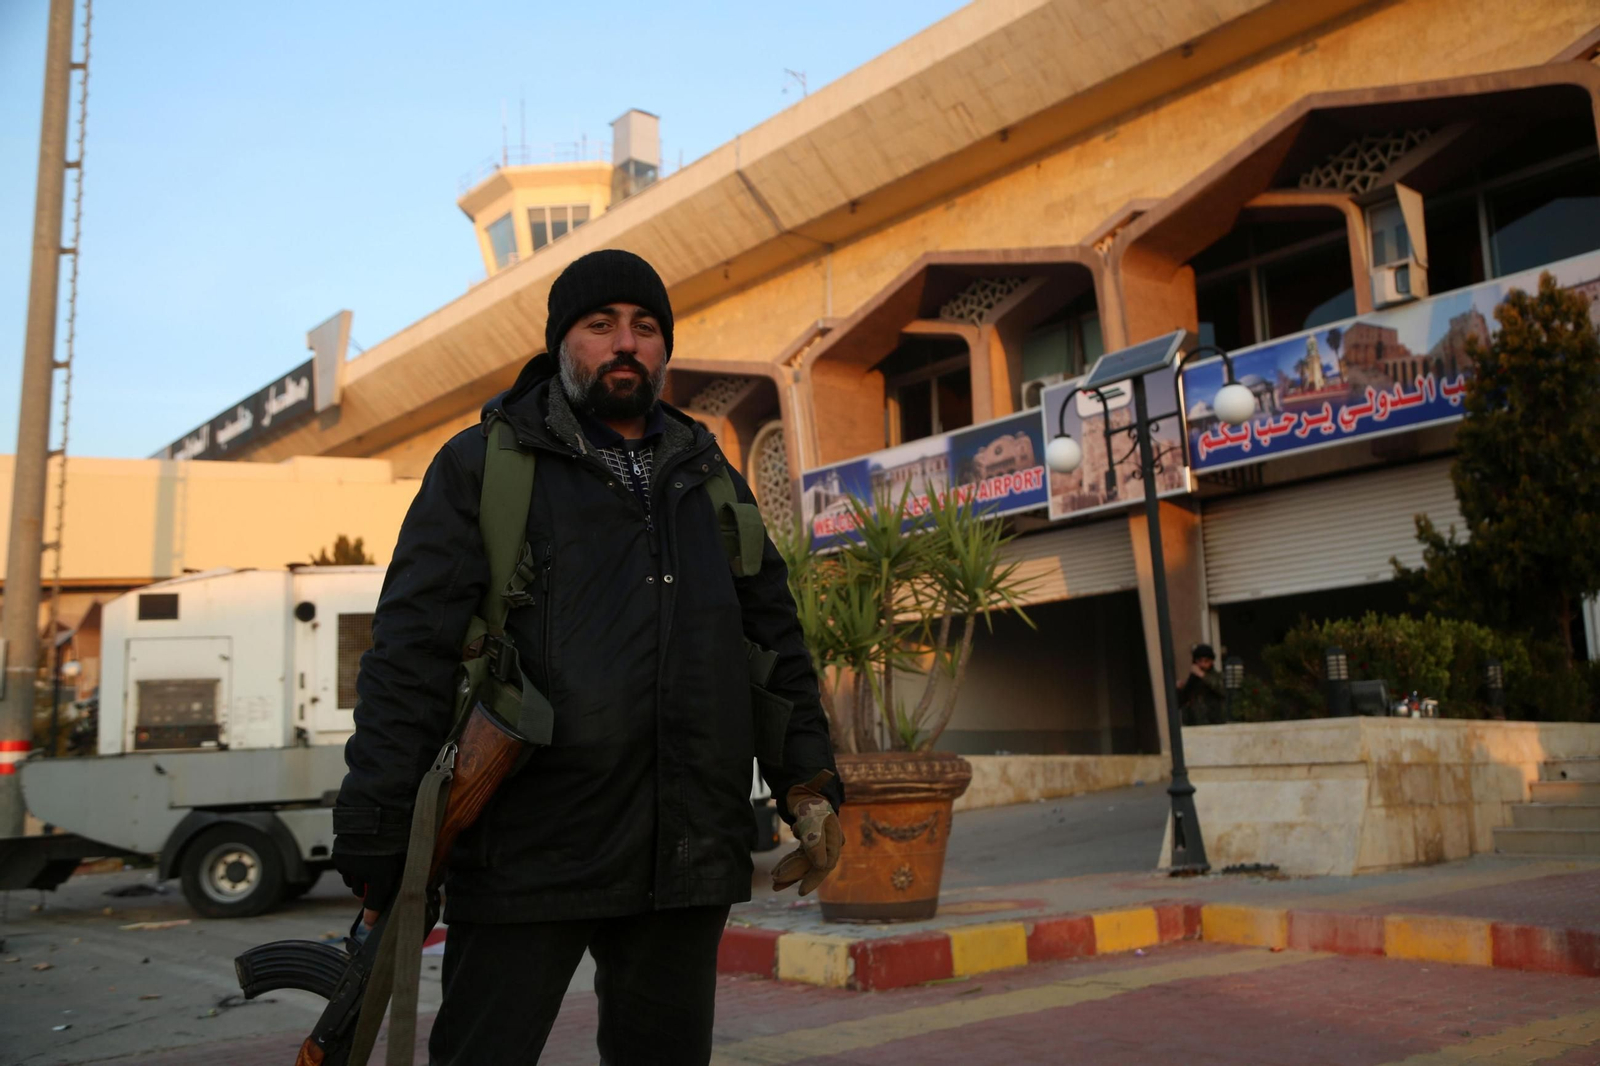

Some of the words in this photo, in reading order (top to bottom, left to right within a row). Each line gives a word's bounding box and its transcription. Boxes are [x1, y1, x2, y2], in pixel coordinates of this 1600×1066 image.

[1254, 401, 1336, 447] يرحب
[1338, 372, 1436, 433] الدولي
[1198, 420, 1252, 461] بكم
[812, 507, 872, 538] WELCO
[977, 466, 1045, 504] AIRPORT
